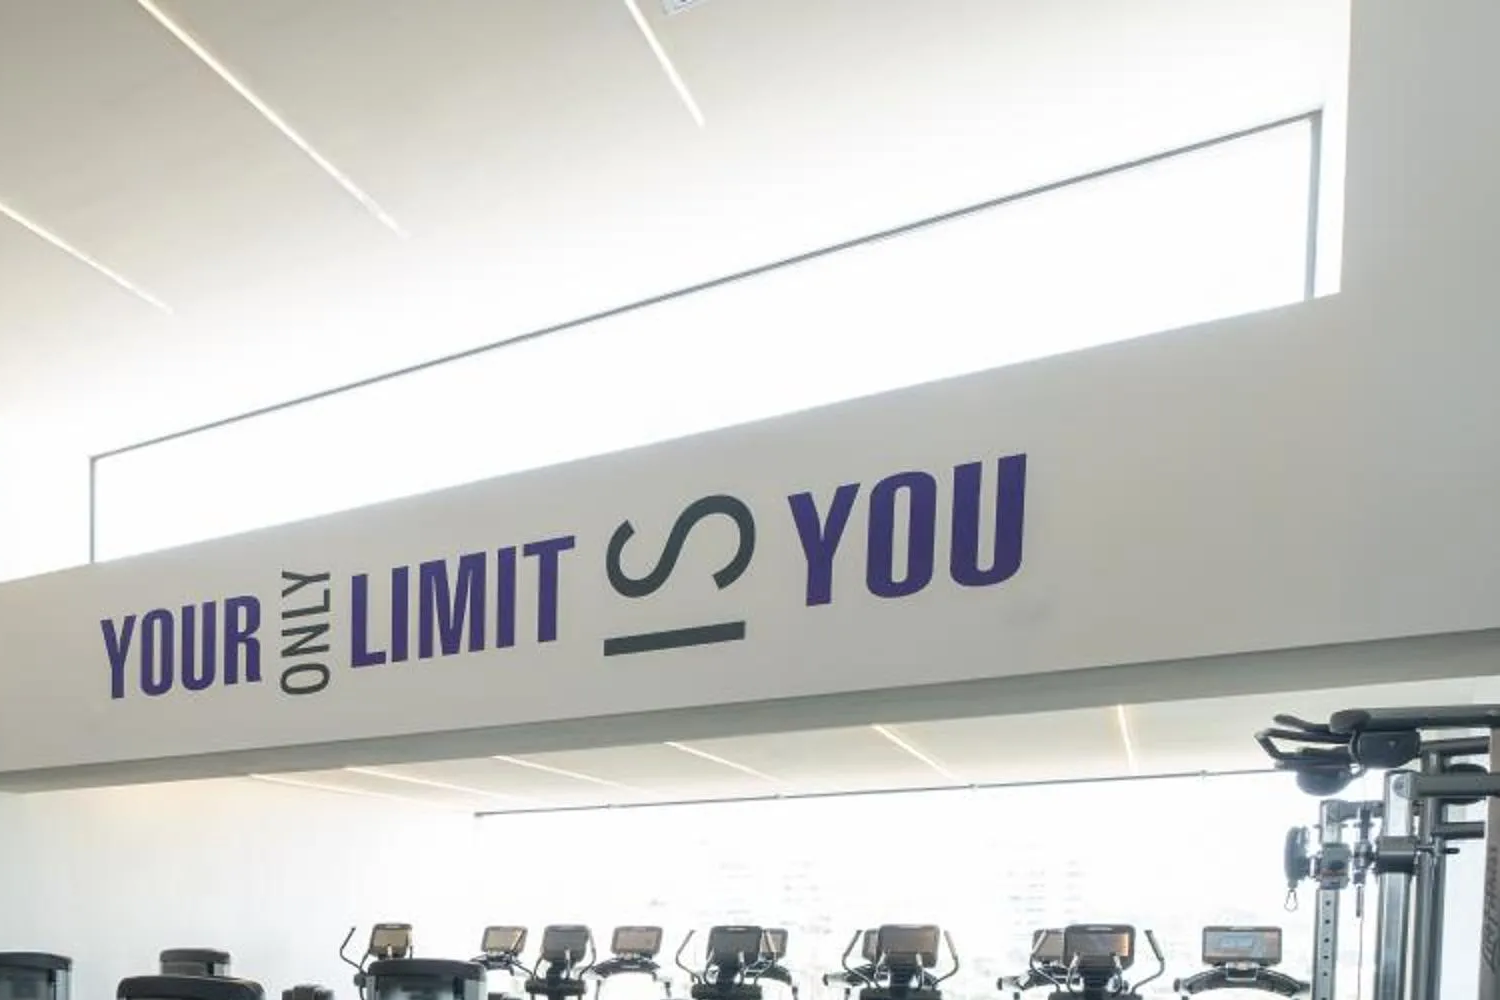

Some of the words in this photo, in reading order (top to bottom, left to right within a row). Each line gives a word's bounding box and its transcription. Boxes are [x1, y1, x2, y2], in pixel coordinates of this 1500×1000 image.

[100, 595, 263, 700] YOUR
[279, 568, 332, 696] ONLY
[349, 534, 576, 669] LIMIT
[603, 493, 757, 657] IS
[787, 452, 1028, 608] YOU
